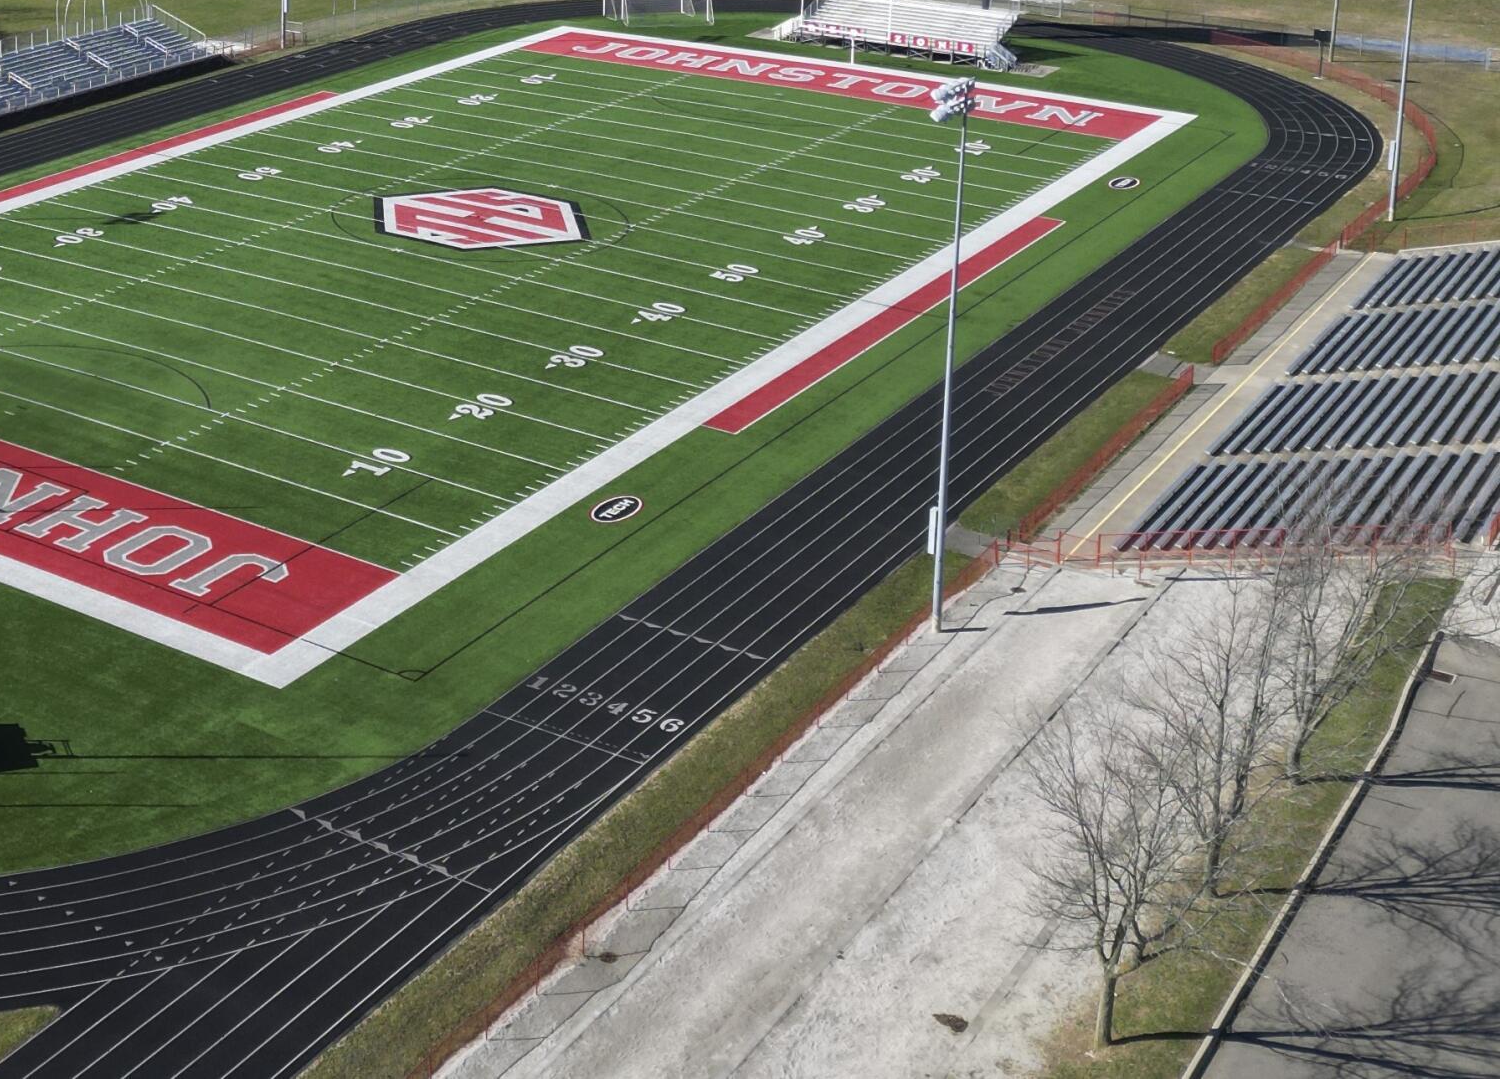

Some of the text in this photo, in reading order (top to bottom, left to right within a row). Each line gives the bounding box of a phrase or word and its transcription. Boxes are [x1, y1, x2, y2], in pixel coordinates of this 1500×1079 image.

[893, 34, 971, 53] ZONE
[237, 167, 282, 181] 50
[901, 167, 941, 183] 20
[151, 196, 193, 212] 40
[843, 196, 886, 214] 30
[55, 227, 104, 246] 30
[783, 228, 826, 246] 40
[709, 263, 759, 282] 50
[637, 302, 687, 322] 40
[550, 345, 604, 368] 30
[455, 393, 514, 420] 20
[350, 448, 411, 477] 10
[598, 498, 636, 519] TECH
[526, 675, 685, 732] 1 2 3 4 5 6
